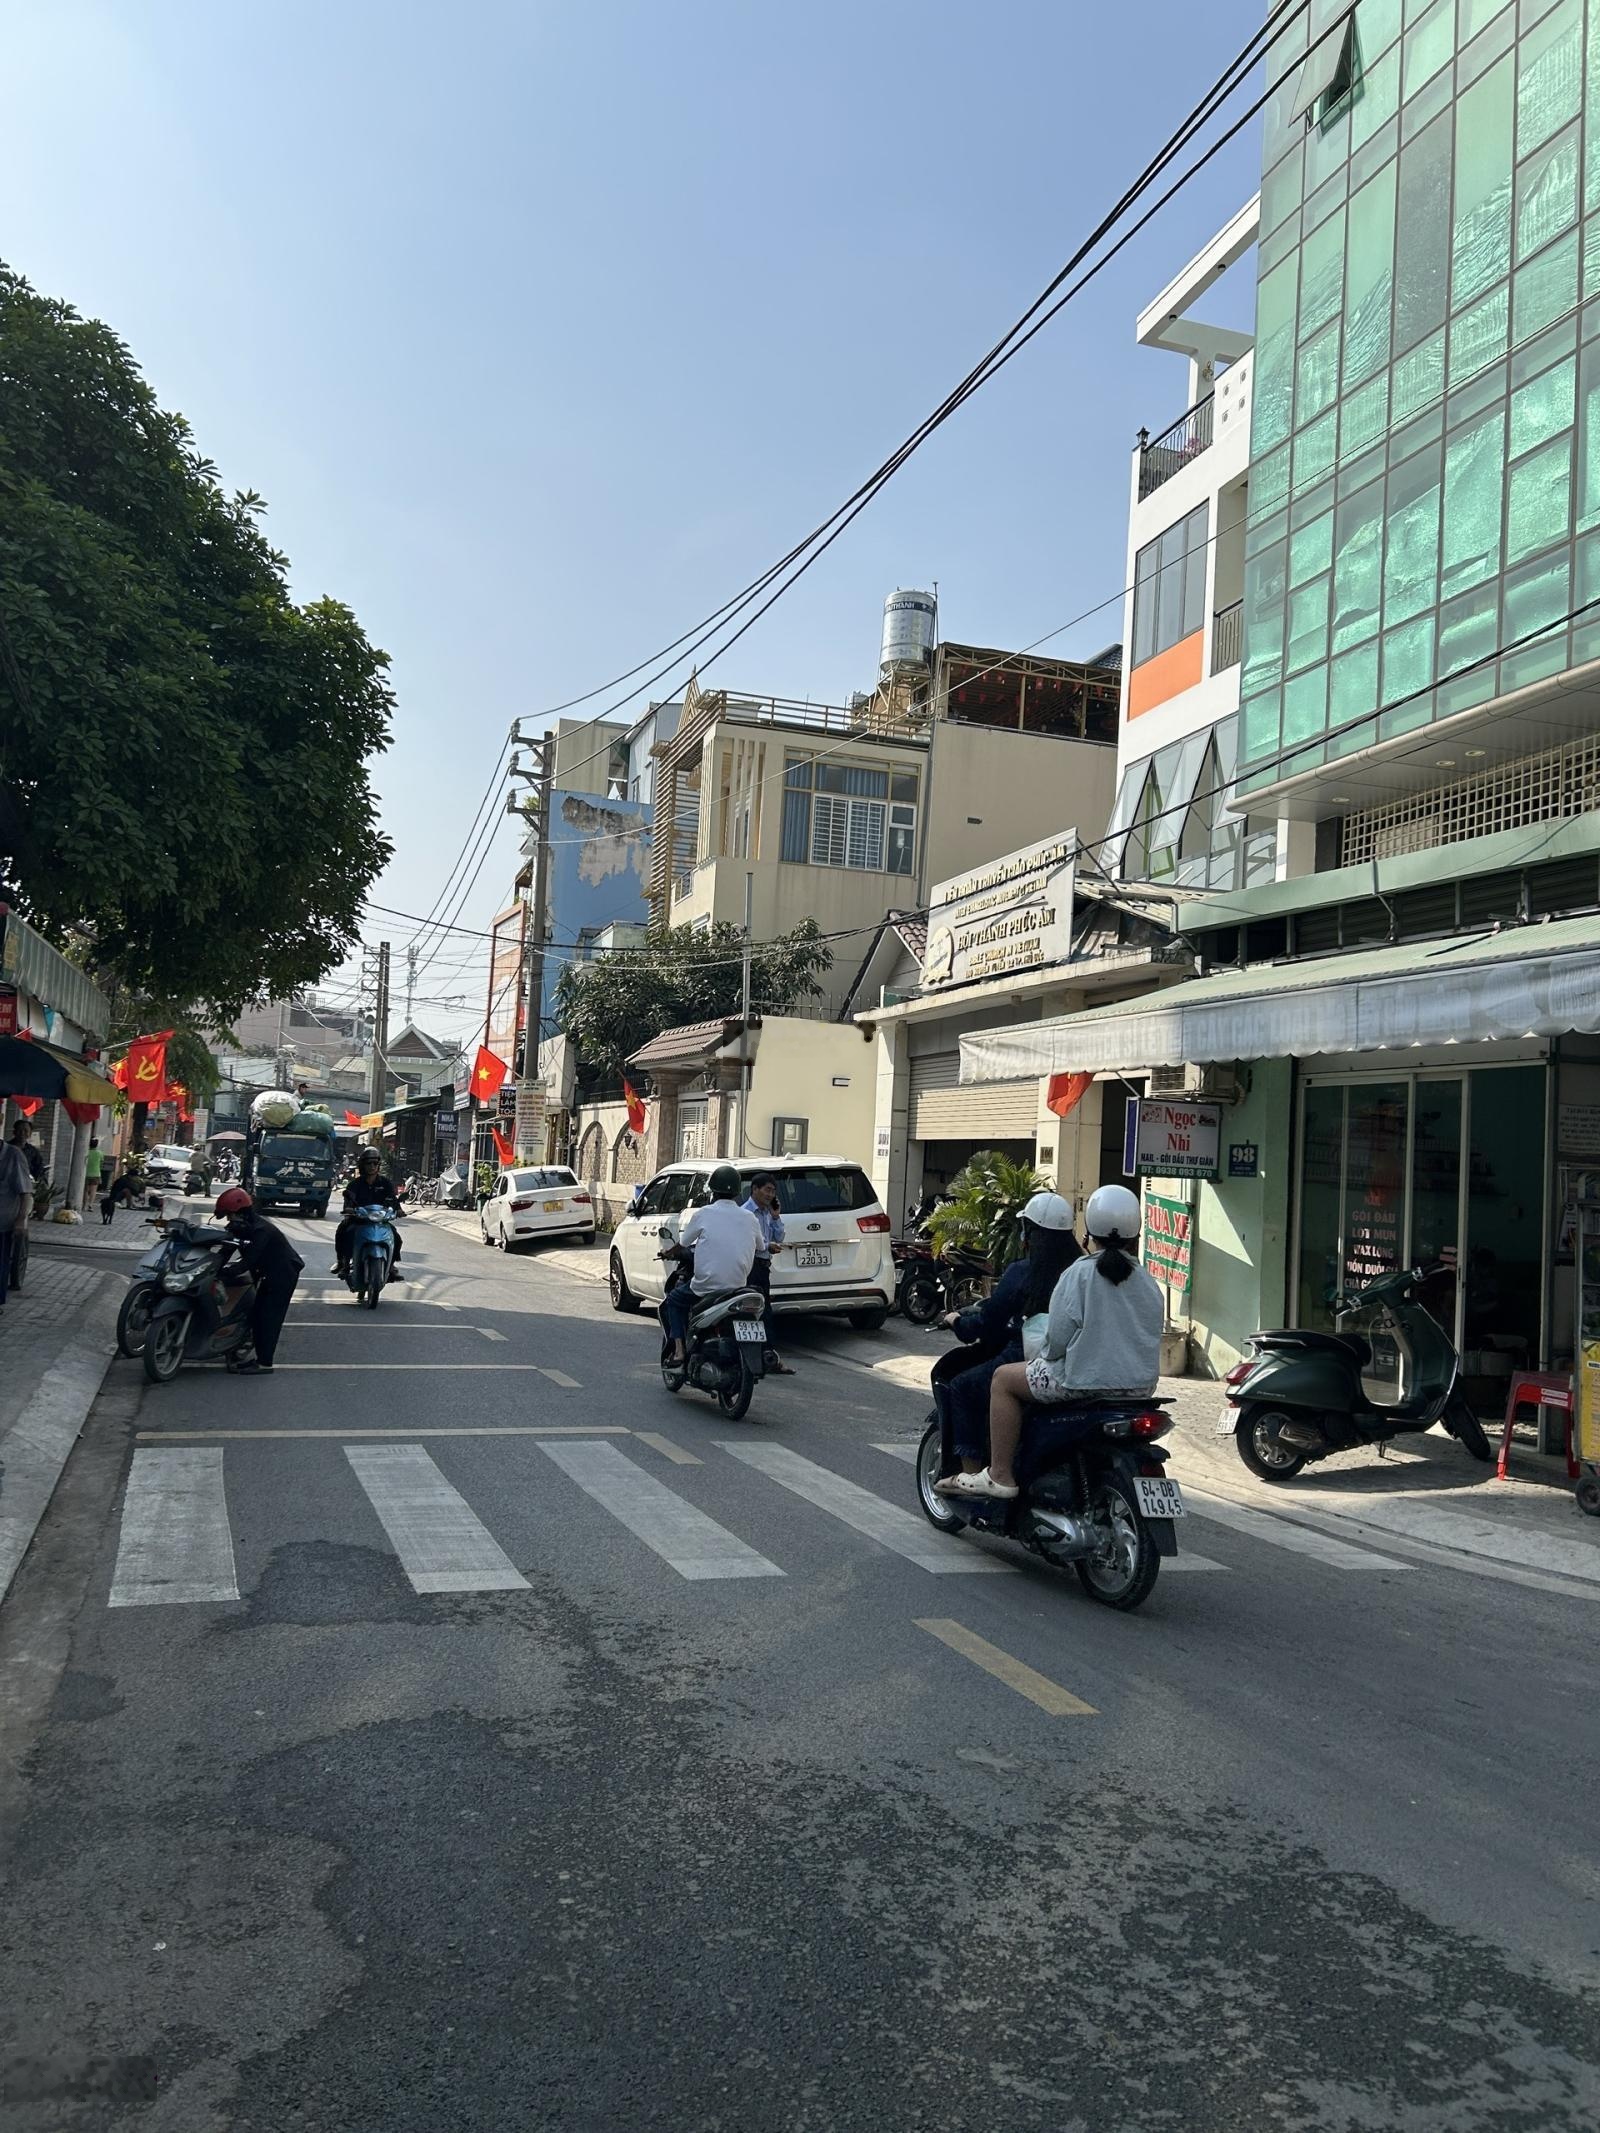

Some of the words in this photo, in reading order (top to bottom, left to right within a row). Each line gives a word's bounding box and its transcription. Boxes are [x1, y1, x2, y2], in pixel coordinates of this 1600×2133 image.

[1164, 1106, 1197, 1130] Ngọc
[1166, 1132, 1191, 1152] Nhi
[1232, 1147, 1255, 1163] 98
[1145, 1198, 1172, 1237] RỬA
[1172, 1210, 1191, 1242] XE
[806, 1248, 821, 1256] 51L
[1354, 1244, 1371, 1256] WAX
[1143, 1498, 1182, 1515] 149.45
